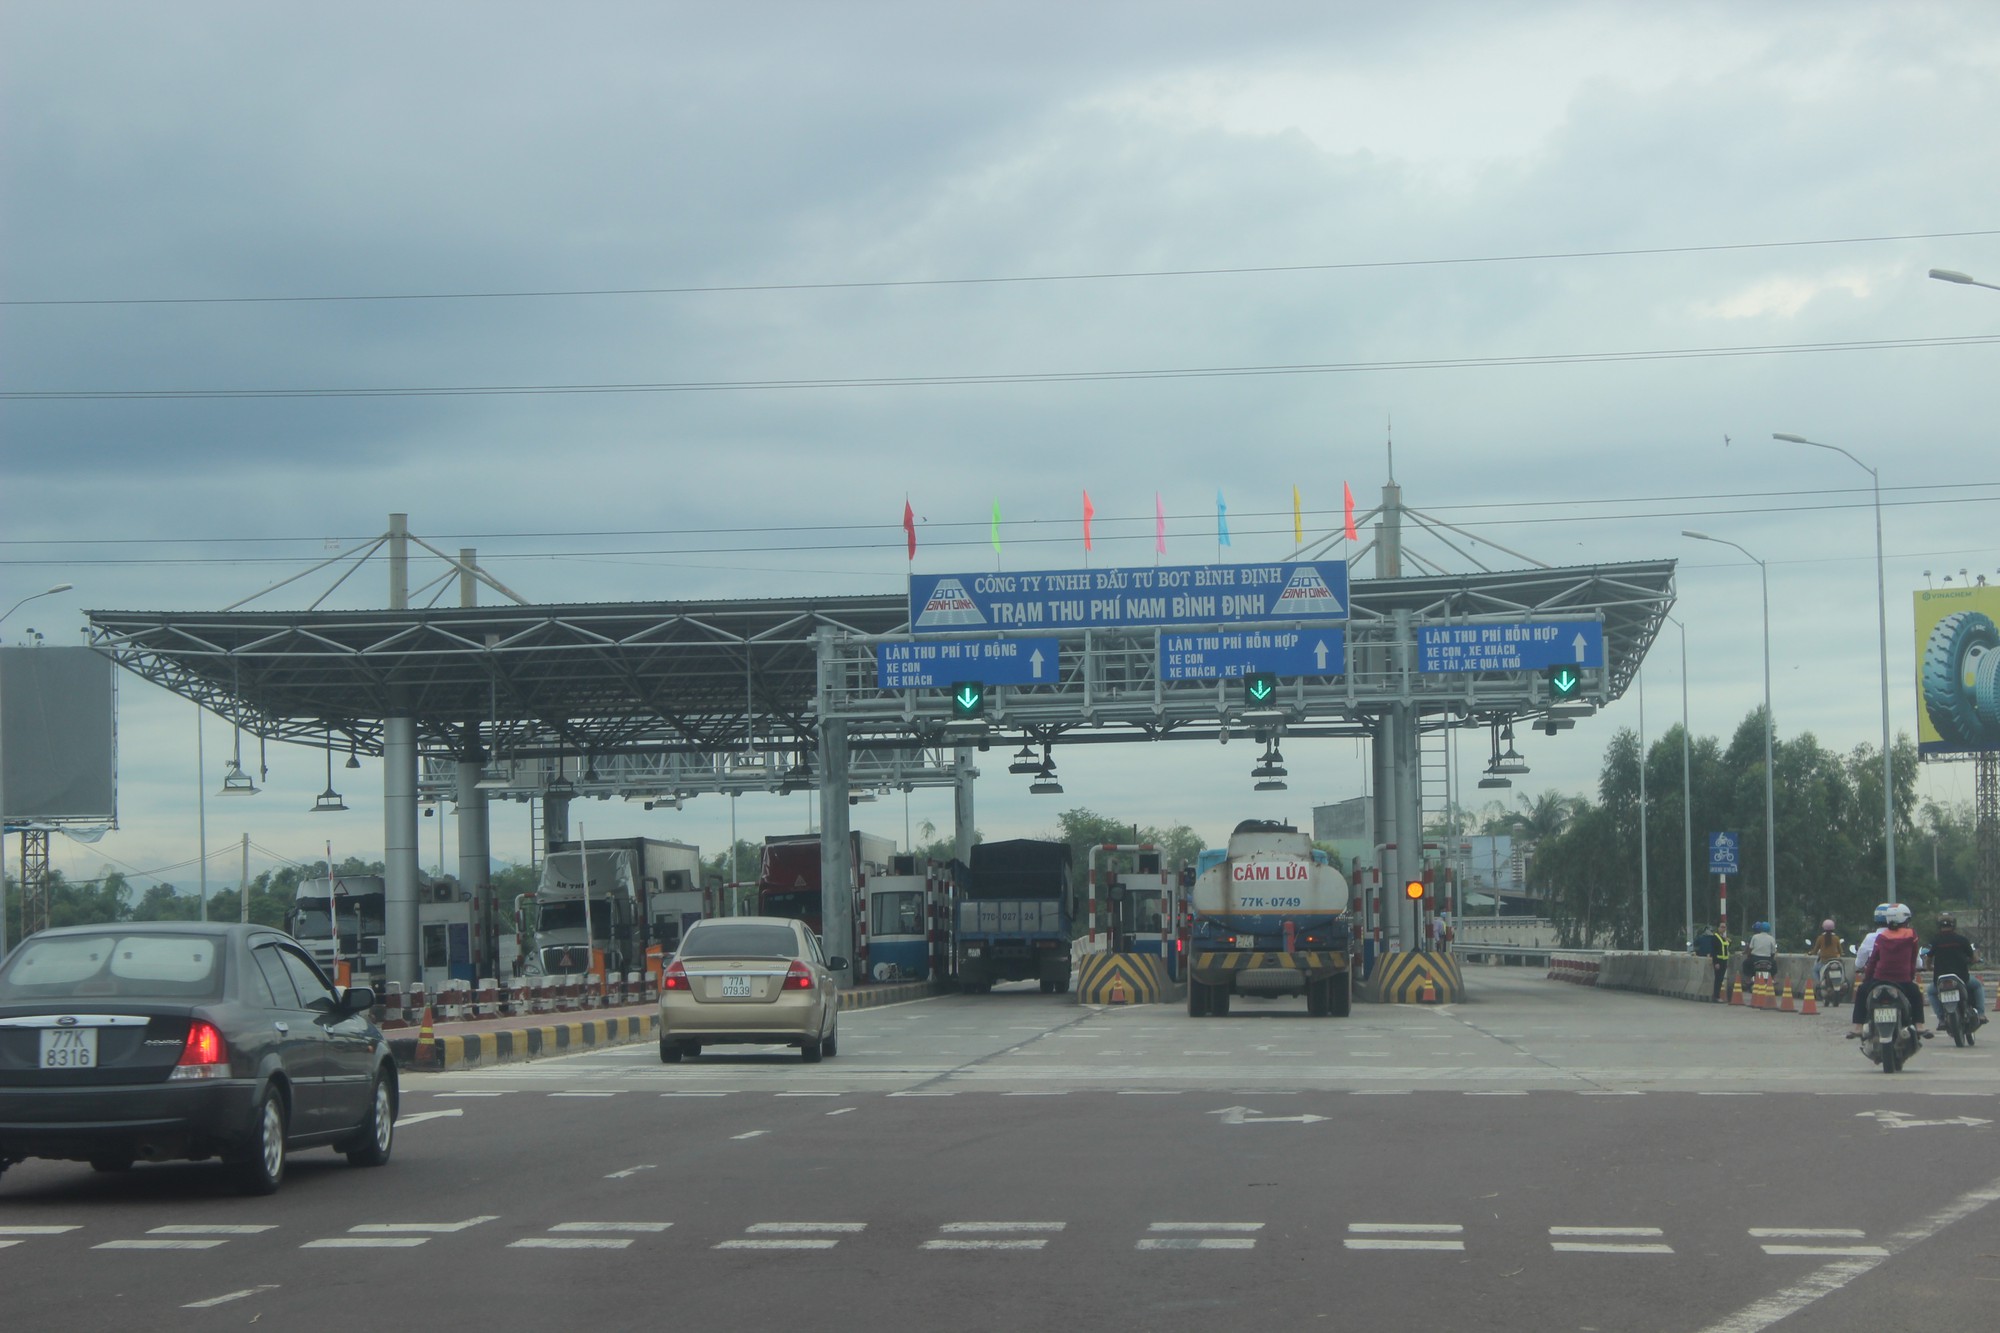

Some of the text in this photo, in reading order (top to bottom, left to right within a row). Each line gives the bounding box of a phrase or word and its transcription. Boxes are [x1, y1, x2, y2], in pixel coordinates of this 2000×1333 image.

[975, 566, 1282, 593] CÔNG TY TNHH ĐẦU TƯ BOT BÌNH ĐỊNH
[1288, 576, 1322, 588] BOT
[932, 588, 965, 599] BOT
[990, 593, 1265, 626] TRẠM THU PHÍ NAM BÌNH ĐỊNH
[1426, 624, 1558, 644] LÀN THU PHÍ HỖN HỢP
[1168, 632, 1298, 651] LÀN THU PHÍ HỖN HỢP
[886, 642, 1017, 660] LÀN THU PHÍ TỰ ĐỘNG
[1427, 647, 1439, 657] XE
[1442, 646, 1461, 657] CON
[1469, 645, 1481, 656] XE
[1484, 642, 1515, 656] KHÁCH
[1169, 654, 1203, 665] XE CON
[1428, 660, 1439, 670] XE
[1443, 656, 1458, 670] TẢI
[1480, 656, 1498, 669] QUÁ
[886, 662, 920, 673] XE CON
[1170, 667, 1181, 678] XE
[1185, 664, 1216, 677] KHÁCH
[1225, 665, 1237, 676] XE
[887, 673, 932, 686] XE KHÁCH
[1234, 862, 1308, 880] CẤM LỬA
[1241, 897, 1300, 907] 77K-0749
[729, 976, 743, 986] 77A
[723, 986, 750, 995] 079.39
[53, 1030, 85, 1048] 77K
[46, 1048, 89, 1066] 8316
